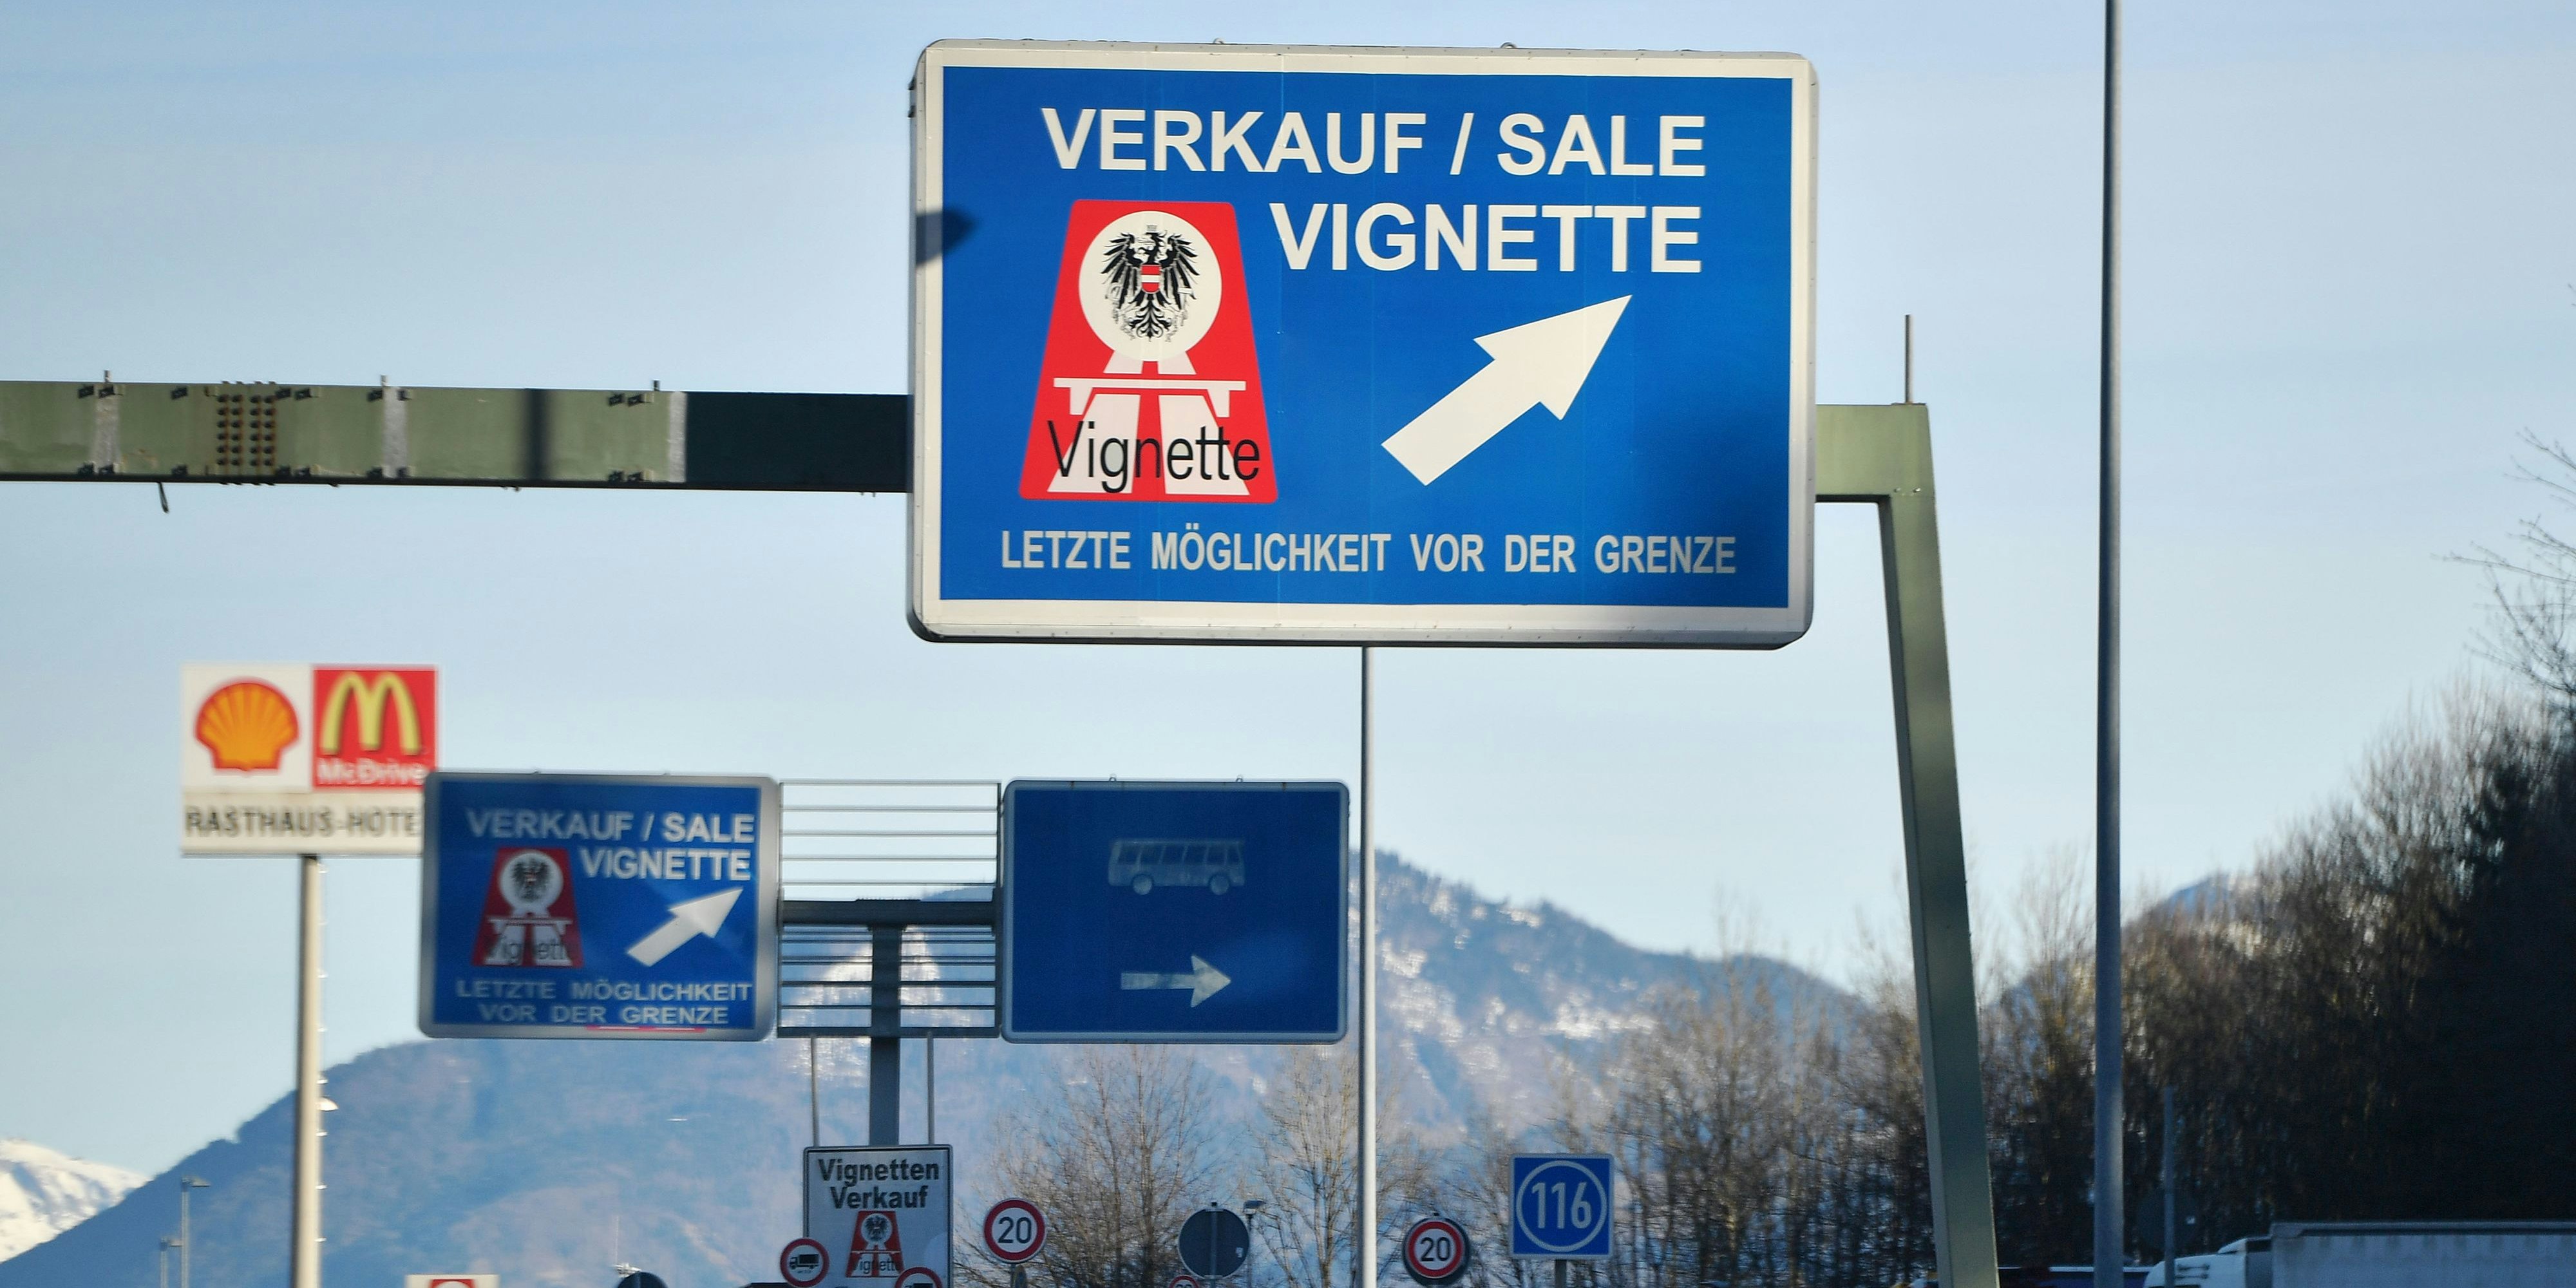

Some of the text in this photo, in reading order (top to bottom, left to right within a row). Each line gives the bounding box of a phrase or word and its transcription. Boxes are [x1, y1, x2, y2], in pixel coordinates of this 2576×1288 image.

[1041, 108, 1706, 176] VERKAUF / SALE
[1269, 203, 1702, 273] VIGNETTE
[1048, 420, 1260, 493] Vignette
[1001, 522, 1736, 574] LETZTE MÖGLICHKEIT VOR DER GRENZE
[317, 757, 428, 785] McDrive
[184, 805, 422, 838] RASTHAUS-HOTE
[466, 808, 634, 840] VERKAUF
[663, 812, 755, 843] SALE
[579, 848, 751, 881] VIGNETTE
[456, 978, 753, 1001] LETZTE MÖGLICHKEIT
[477, 1003, 729, 1024] VOR DER GRENZE
[818, 1159, 940, 1187] Vignetten
[830, 1185, 929, 1209] Verkauf
[1531, 1182, 1592, 1229] 116
[998, 1216, 1032, 1244] 20
[1419, 1236, 1451, 1262] 20
